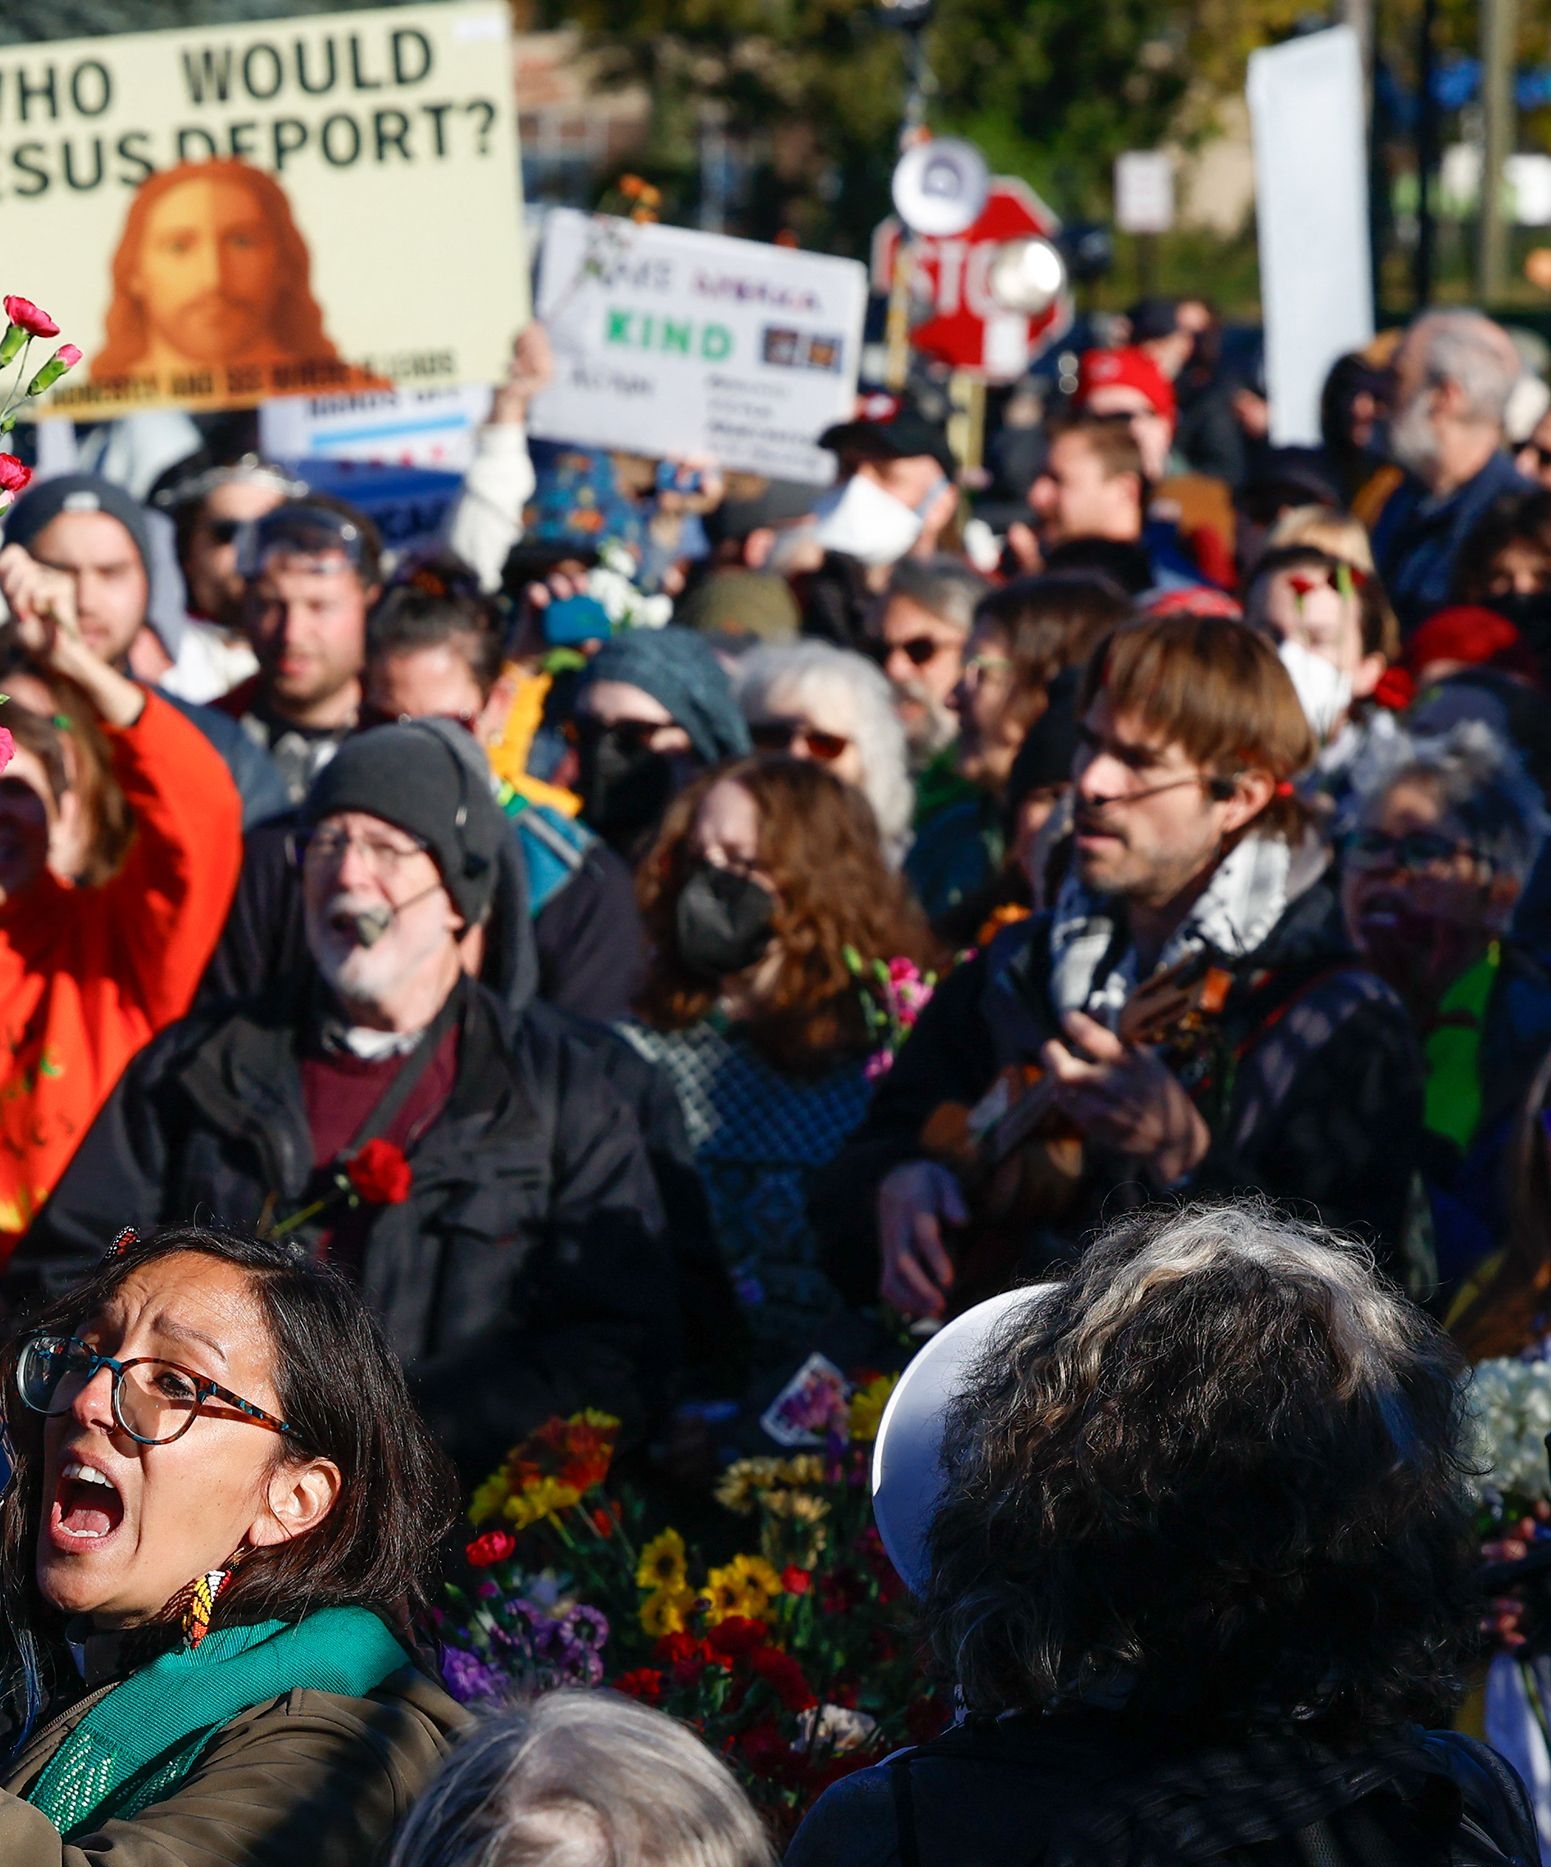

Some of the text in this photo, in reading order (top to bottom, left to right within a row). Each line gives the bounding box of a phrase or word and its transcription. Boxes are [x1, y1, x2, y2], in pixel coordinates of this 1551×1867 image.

[181, 27, 434, 104] WOULD
[177, 100, 497, 171] DEPORT?
[606, 307, 735, 362] KIND
